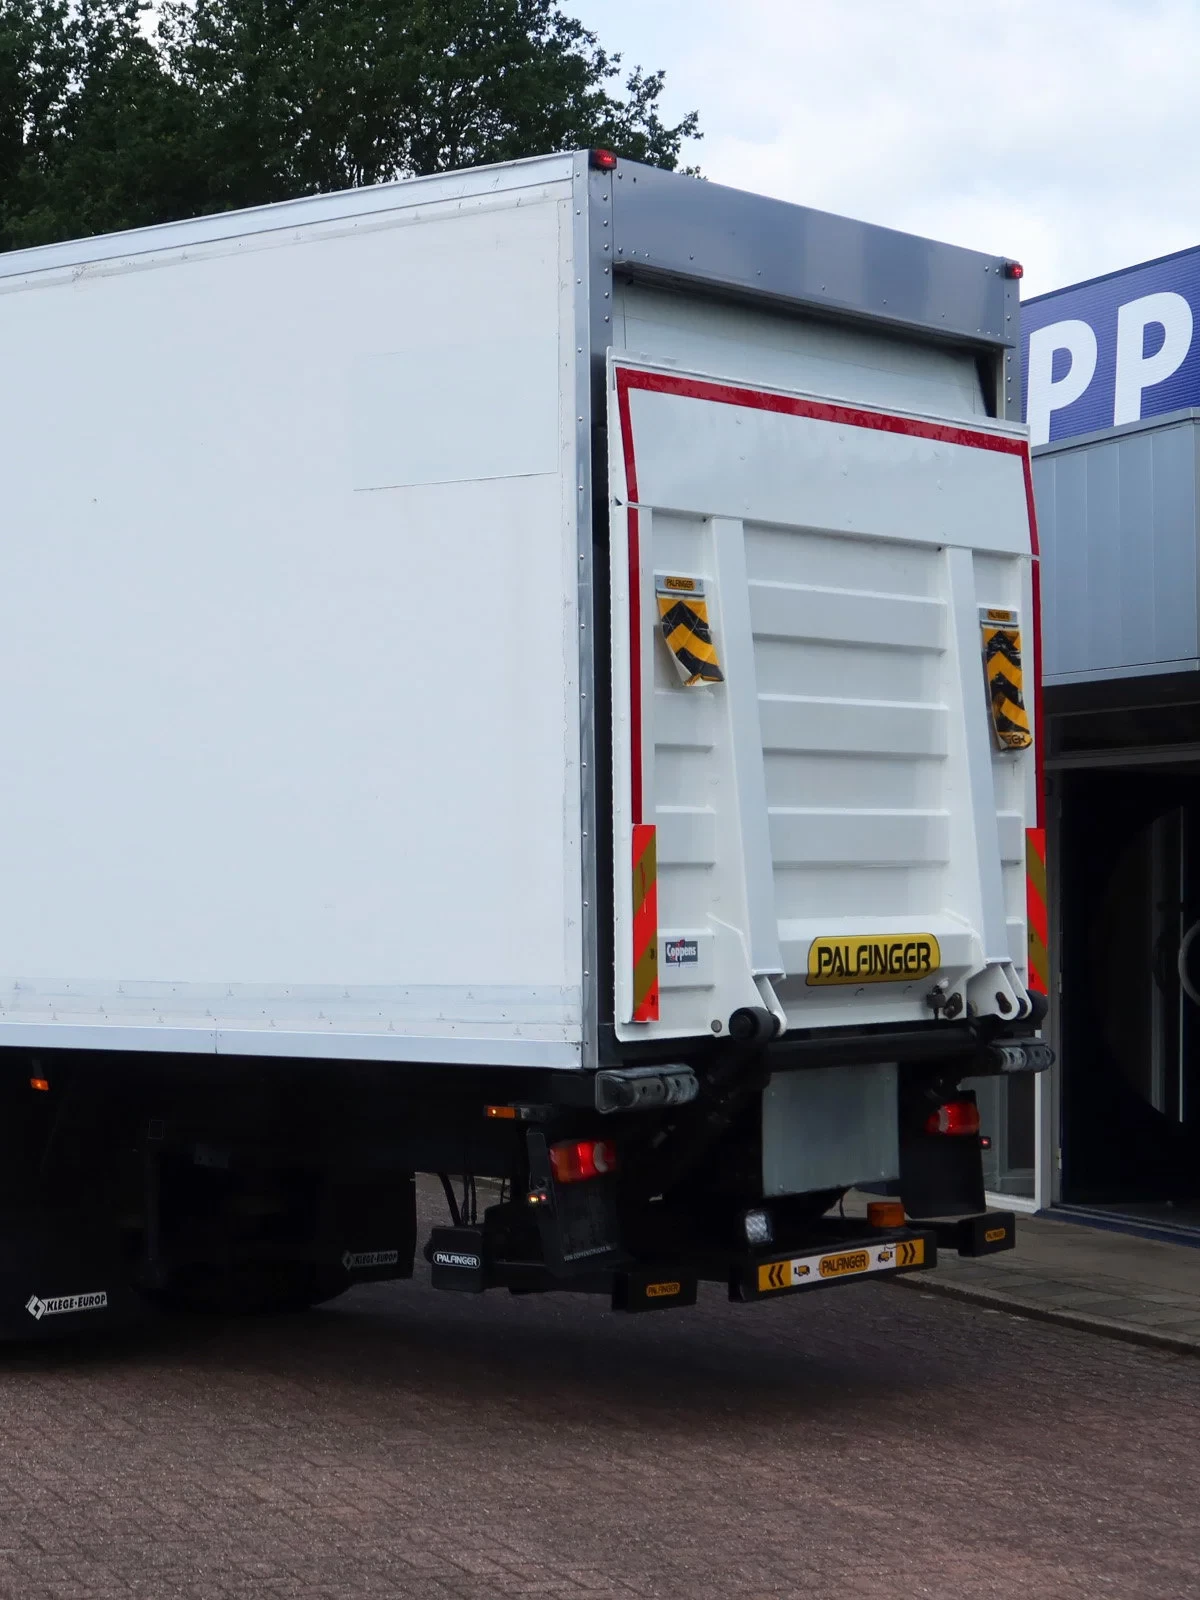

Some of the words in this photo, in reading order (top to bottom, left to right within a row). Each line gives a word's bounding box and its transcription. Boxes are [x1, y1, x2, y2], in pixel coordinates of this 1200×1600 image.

[666, 943, 697, 962] Coppens
[814, 941, 932, 979] PALFINGER
[436, 1253, 478, 1267] PALFINGER
[821, 1253, 868, 1275] PALFINGER
